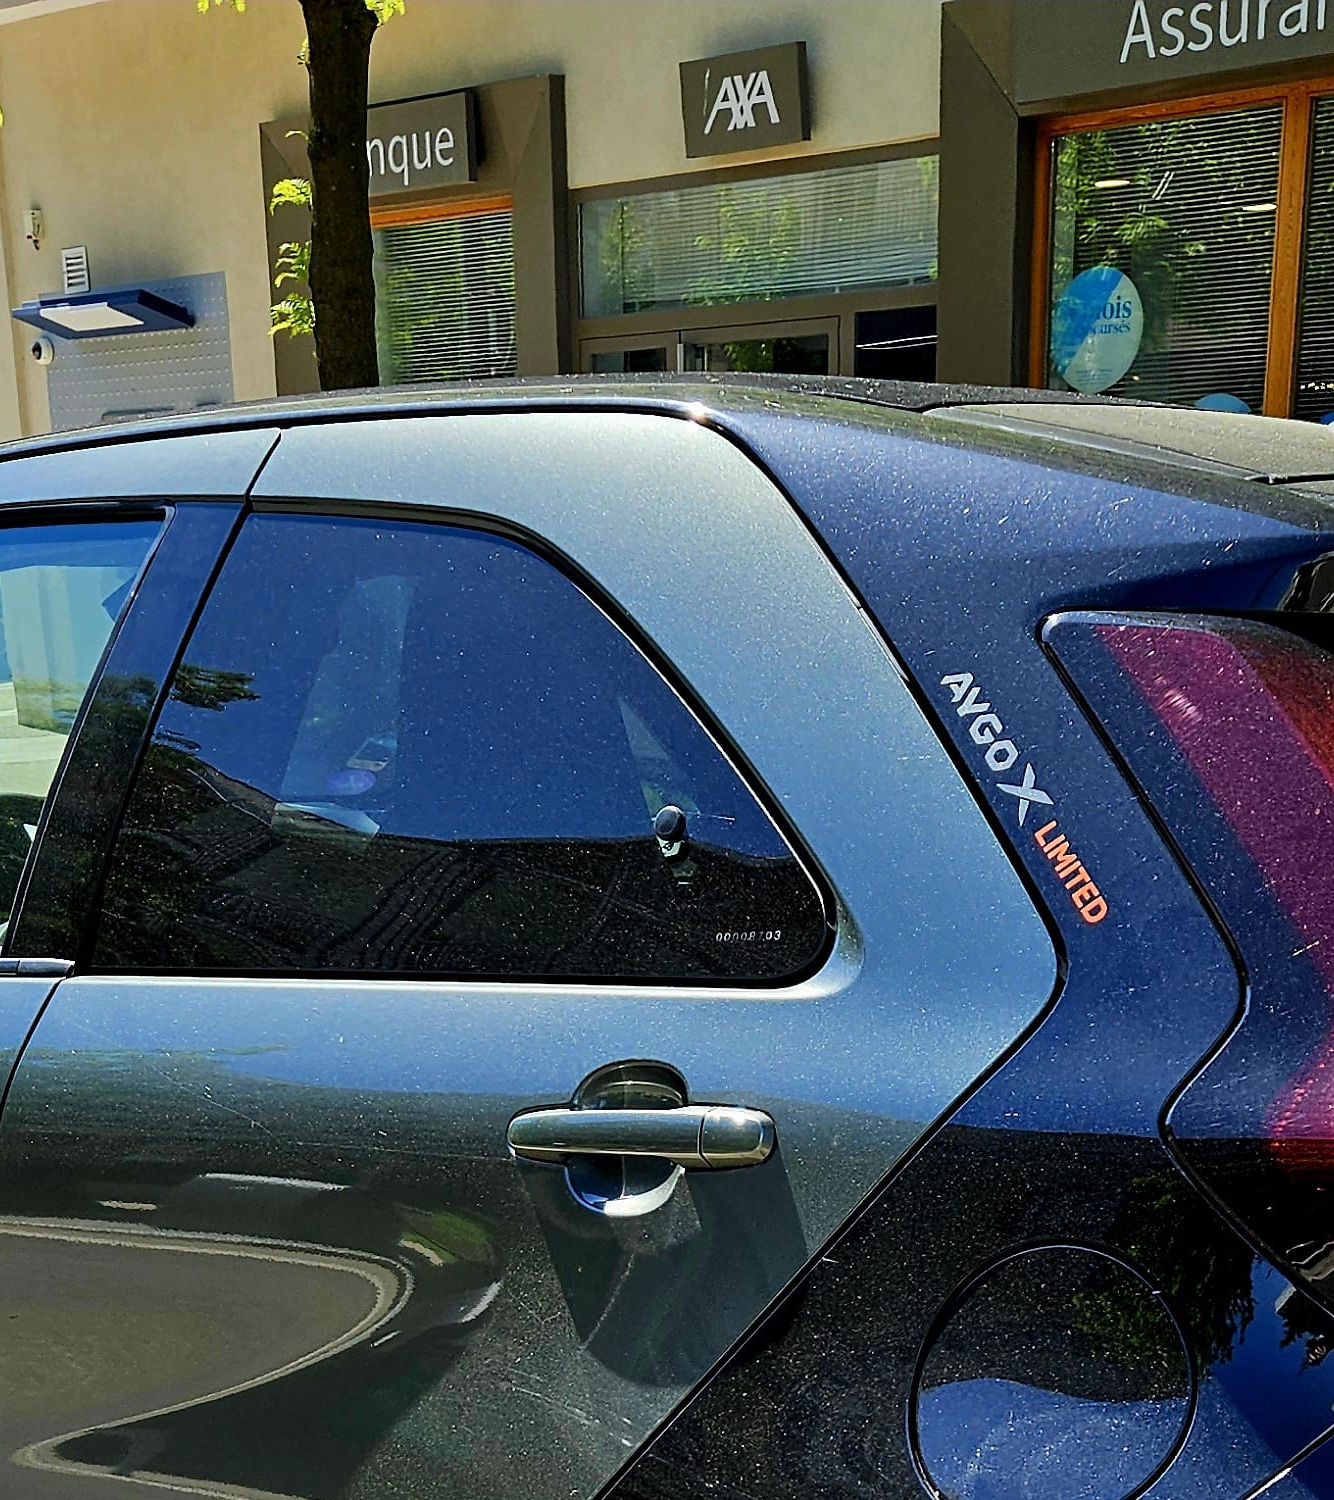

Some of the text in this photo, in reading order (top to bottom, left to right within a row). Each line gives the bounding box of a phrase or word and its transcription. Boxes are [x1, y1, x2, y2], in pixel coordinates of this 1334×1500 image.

[704, 70, 780, 134] AXA
[366, 127, 454, 186] nque
[1099, 296, 1132, 320] ois
[940, 672, 1018, 772] AYGO
[1034, 819, 1108, 925] LIMITED
